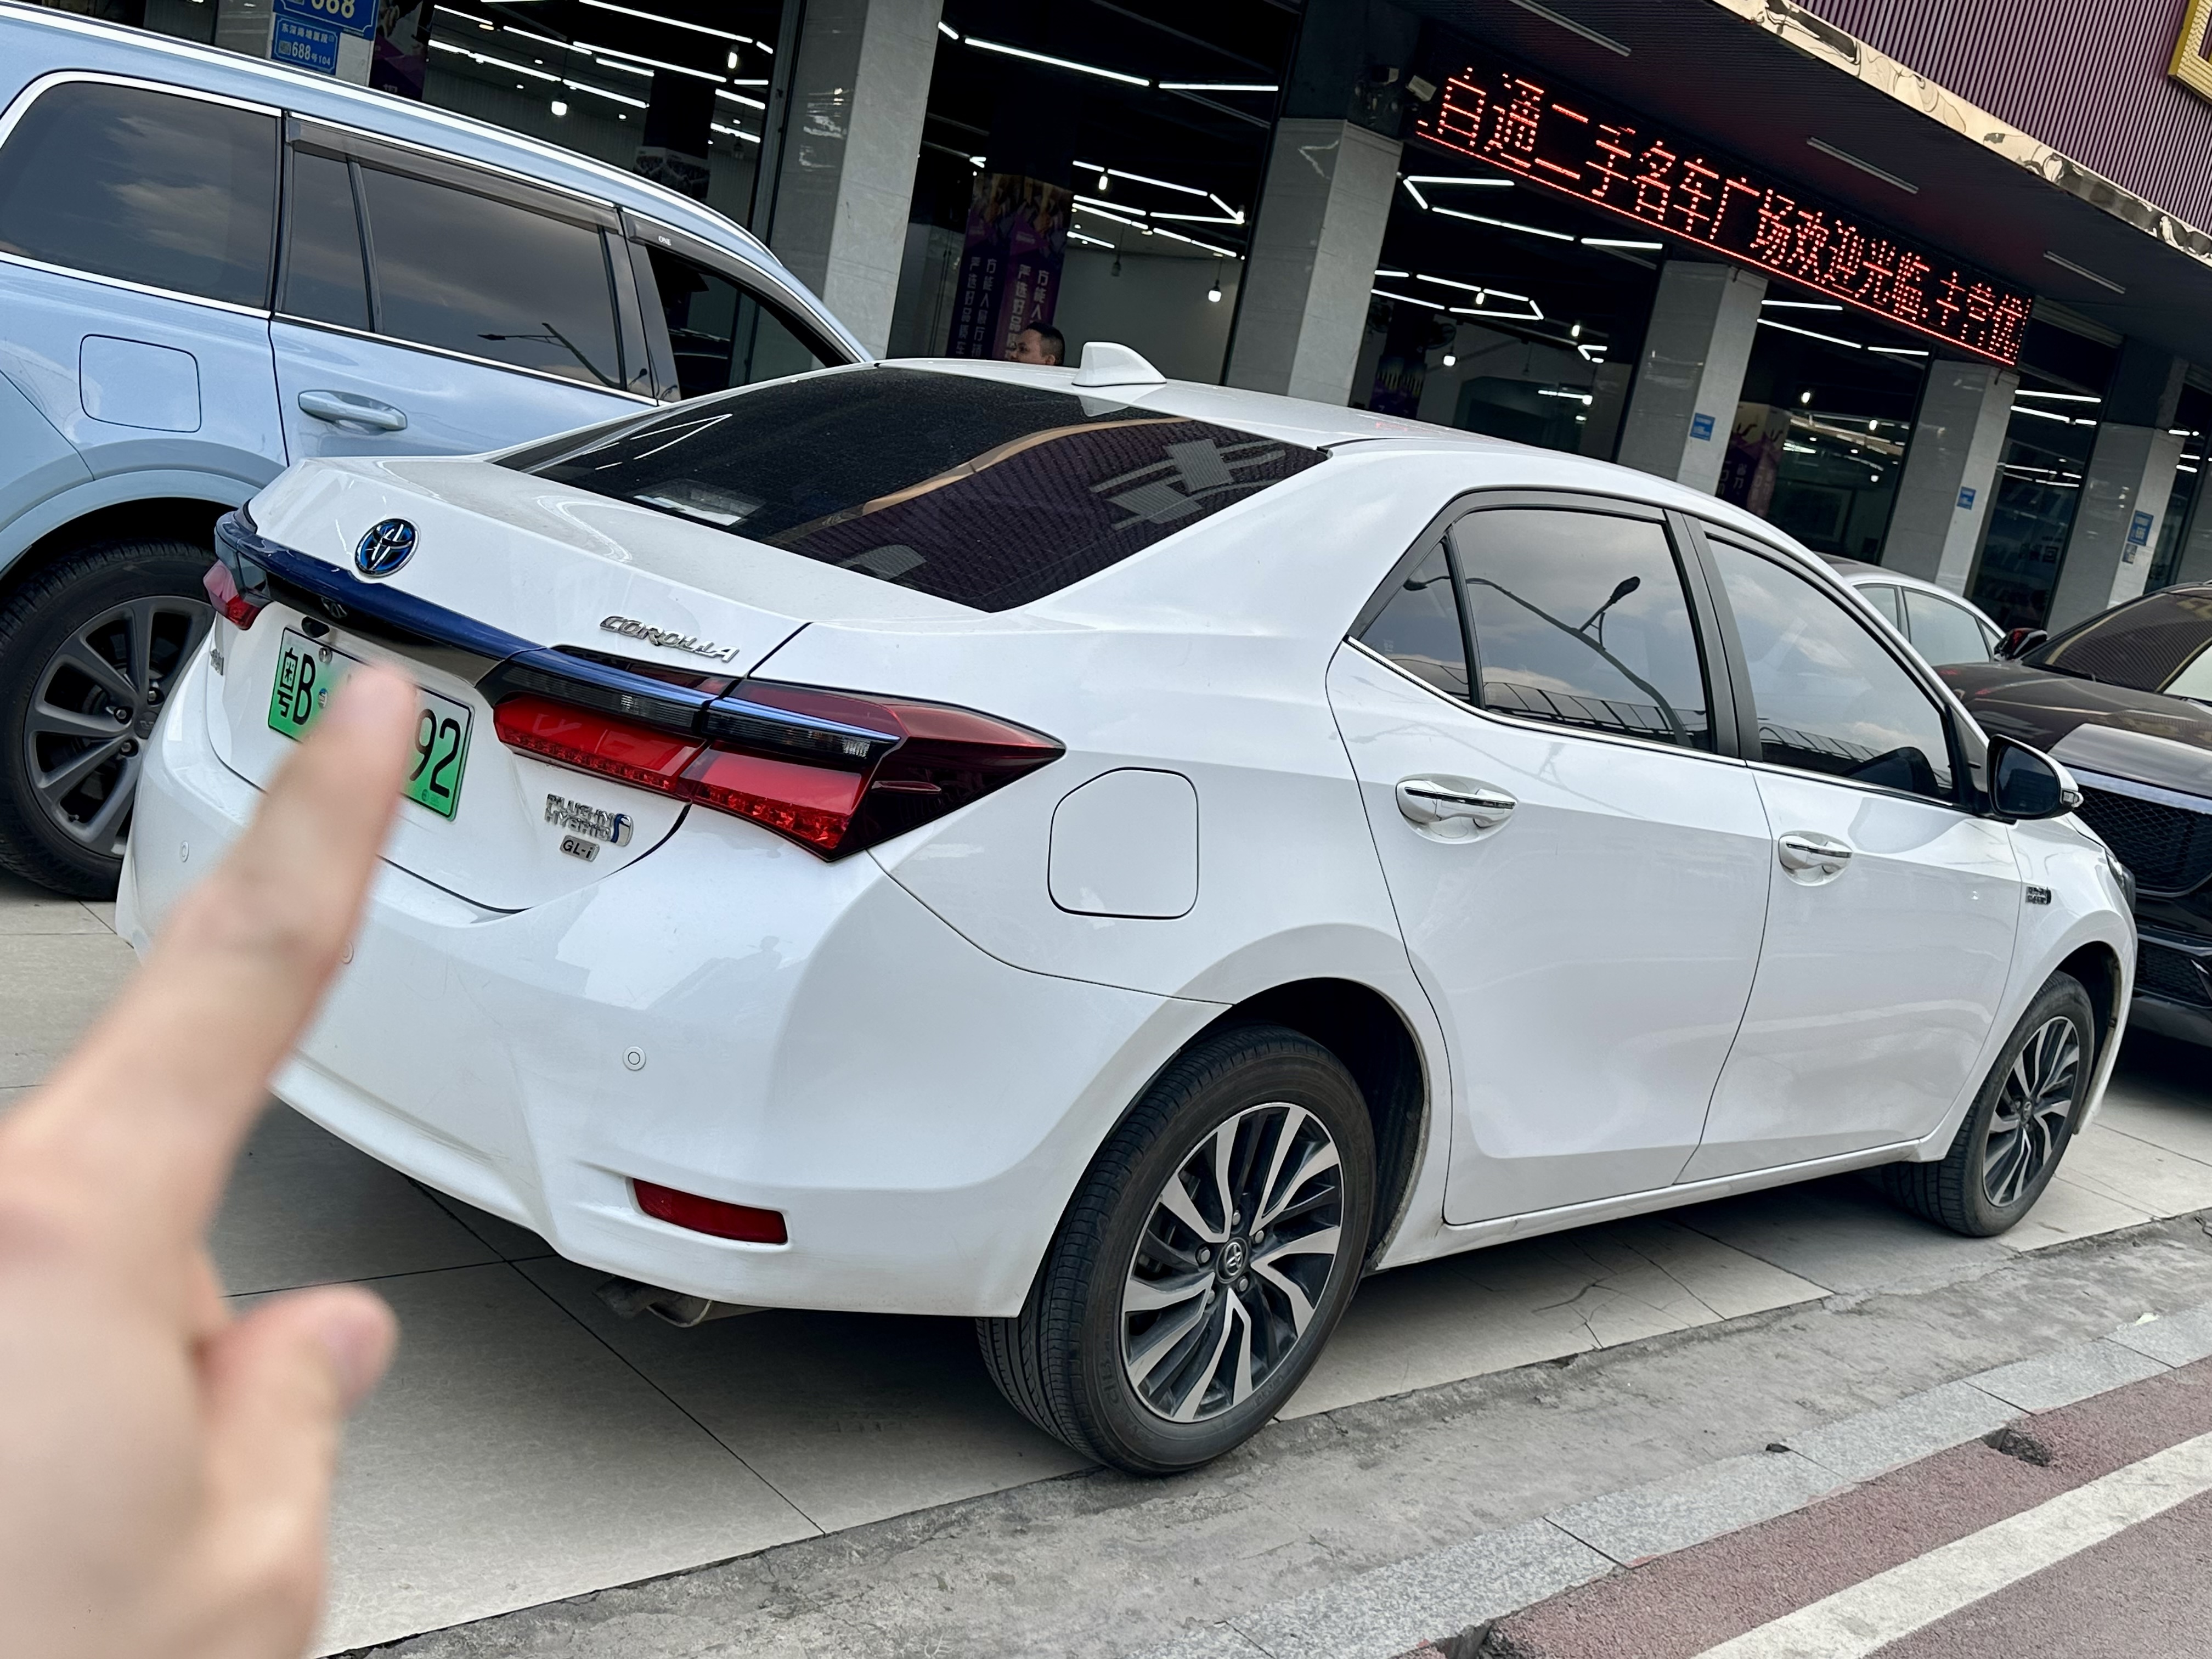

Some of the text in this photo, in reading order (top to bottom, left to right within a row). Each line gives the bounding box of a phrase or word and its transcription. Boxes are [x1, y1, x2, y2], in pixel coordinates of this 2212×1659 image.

[600, 615, 740, 663] COROLLA
[544, 808, 612, 842] HYBRID
[562, 839, 593, 859] GL-i
